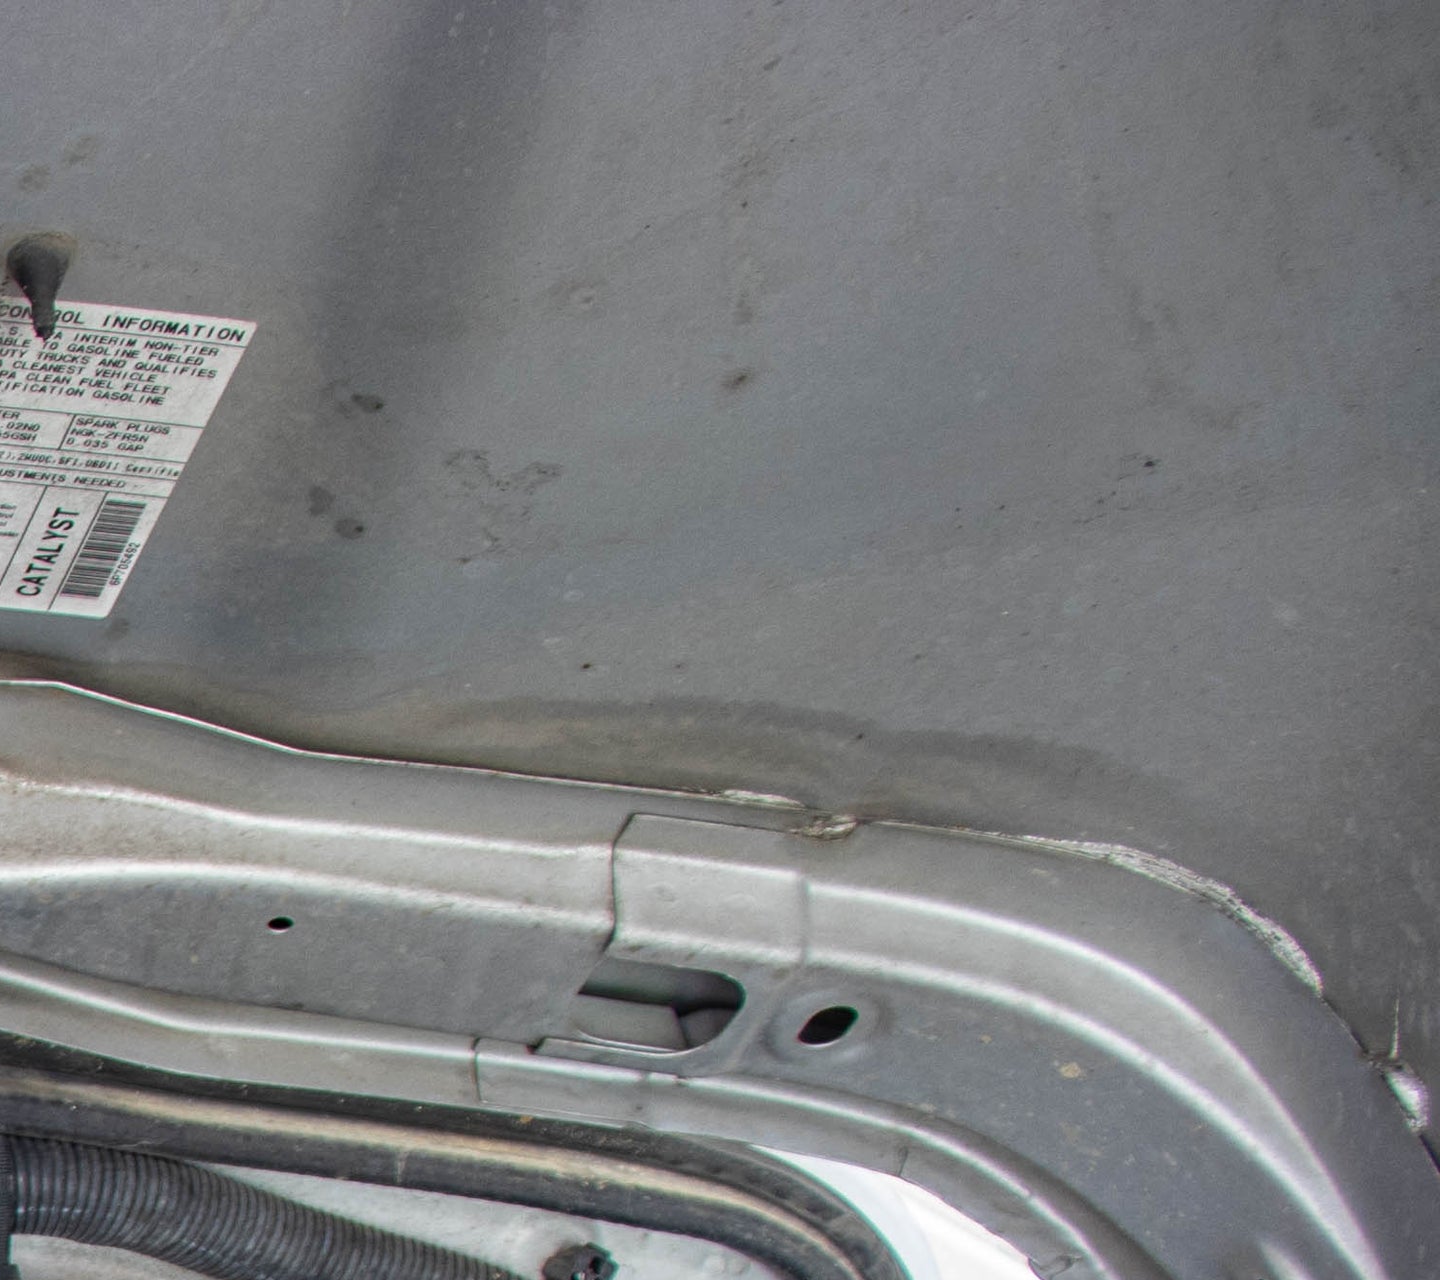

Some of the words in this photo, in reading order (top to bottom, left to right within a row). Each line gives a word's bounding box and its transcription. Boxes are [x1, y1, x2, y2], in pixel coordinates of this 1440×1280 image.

[100, 314, 247, 342] INFORMATION
[40, 340, 59, 351] TO
[65, 343, 141, 359] GASOLINE
[146, 351, 206, 366] FUELED
[71, 332, 138, 349] INTERIM
[142, 340, 221, 357] NON-TIER
[10, 359, 86, 375] CLEANEST
[92, 368, 158, 383] VEHICLE
[35, 351, 91, 365] TRUCKS
[96, 357, 128, 369] AND
[132, 361, 219, 379] QUALIFIES
[24, 372, 78, 386] CLEAN
[77, 377, 116, 389] FUEL
[122, 381, 172, 395] FLEET
[90, 389, 167, 405] GASOLINE
[74, 417, 119, 430] SPARK
[125, 422, 172, 435] PLUGS
[115, 441, 146, 452] GAP
[72, 475, 128, 488] NEEDED
[13, 506, 82, 598] CATALYST
